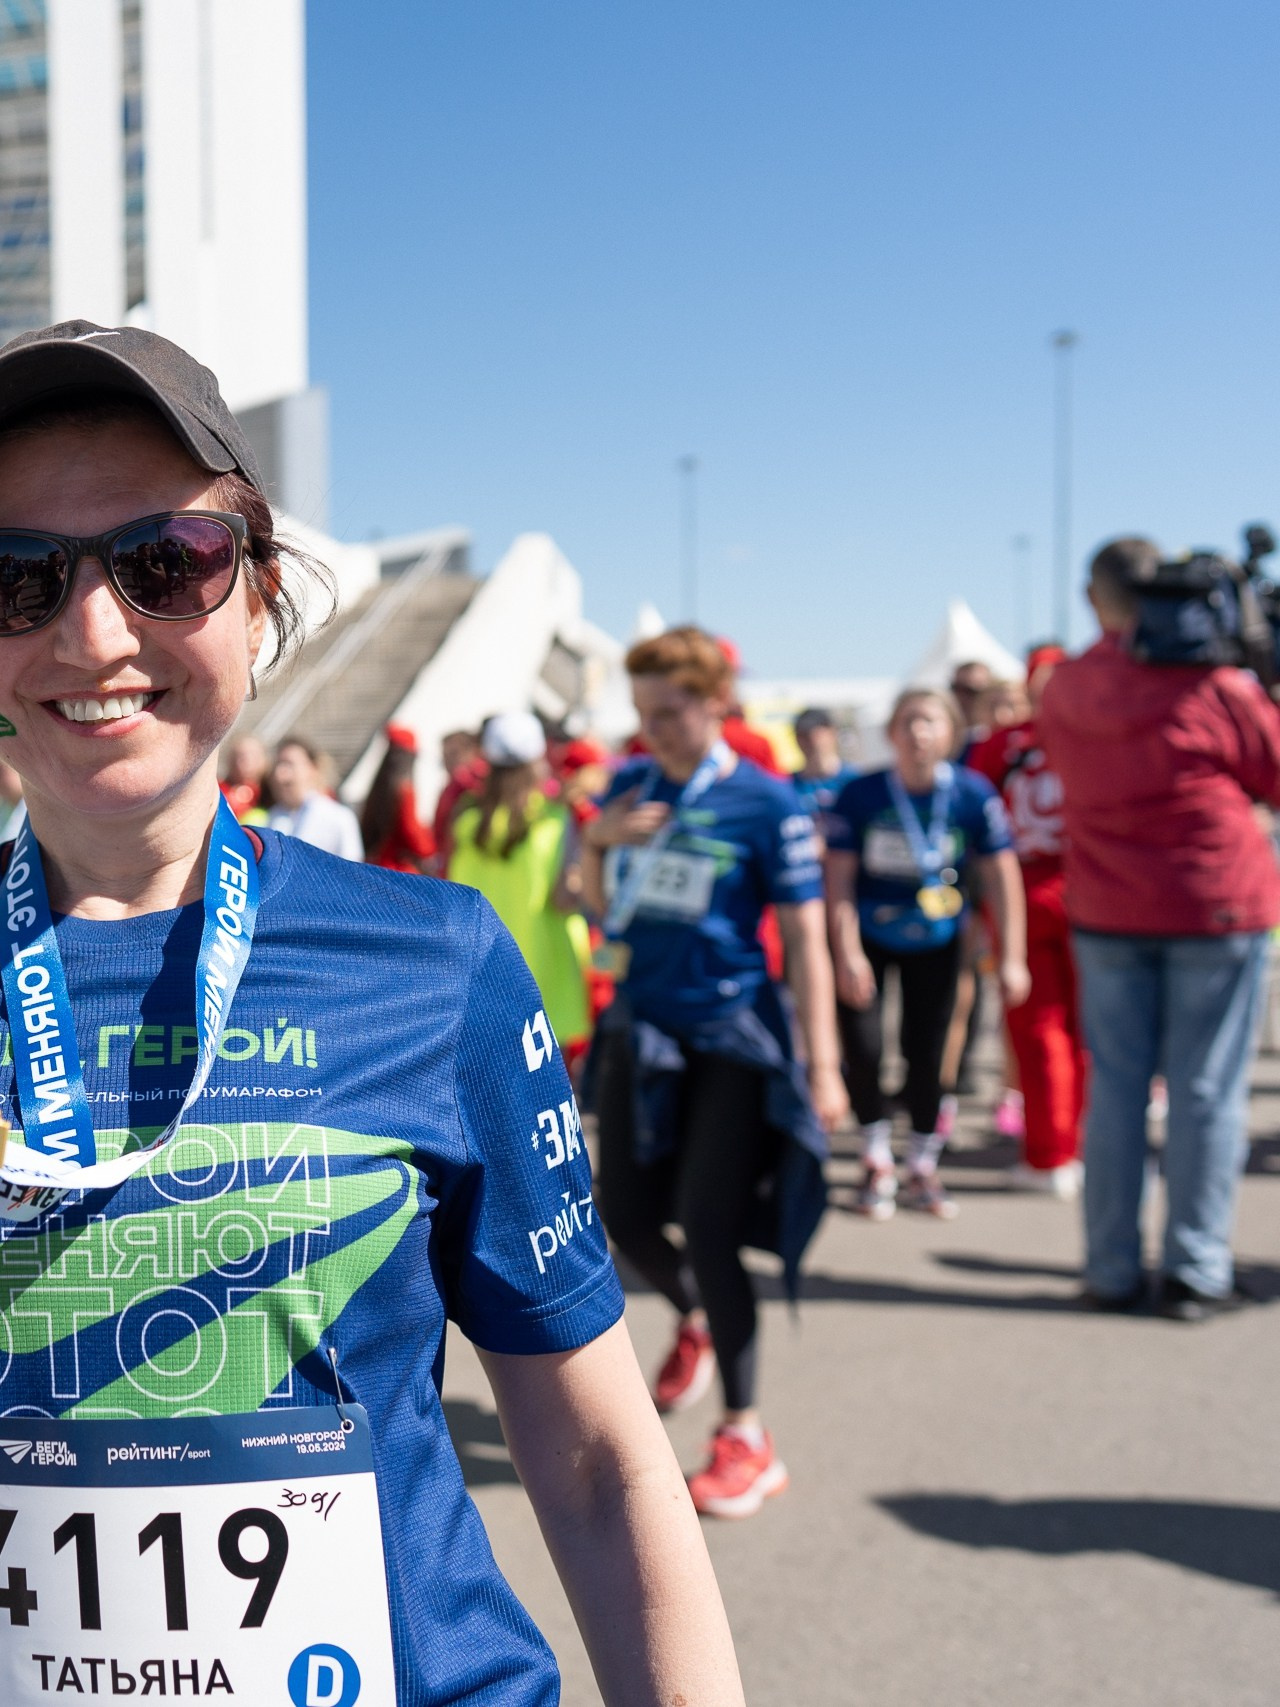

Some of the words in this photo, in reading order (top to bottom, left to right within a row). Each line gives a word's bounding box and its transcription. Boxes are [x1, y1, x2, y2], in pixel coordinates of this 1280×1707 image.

[214, 844, 248, 968] ГЕРОИ
[11, 942, 74, 1124] МЕНЯЮТ
[97, 1017, 318, 1069] ГЕРОЙ!
[31, 1451, 77, 1467] ГЕРОЙ!
[241, 1433, 288, 1448] НИЖНИЙ
[290, 1430, 346, 1444] НОВГОРОД
[296, 1441, 346, 1454] 19.05.2024
[31, 1653, 235, 1696] ТАТЬЯНА
[305, 1653, 345, 1707] D
